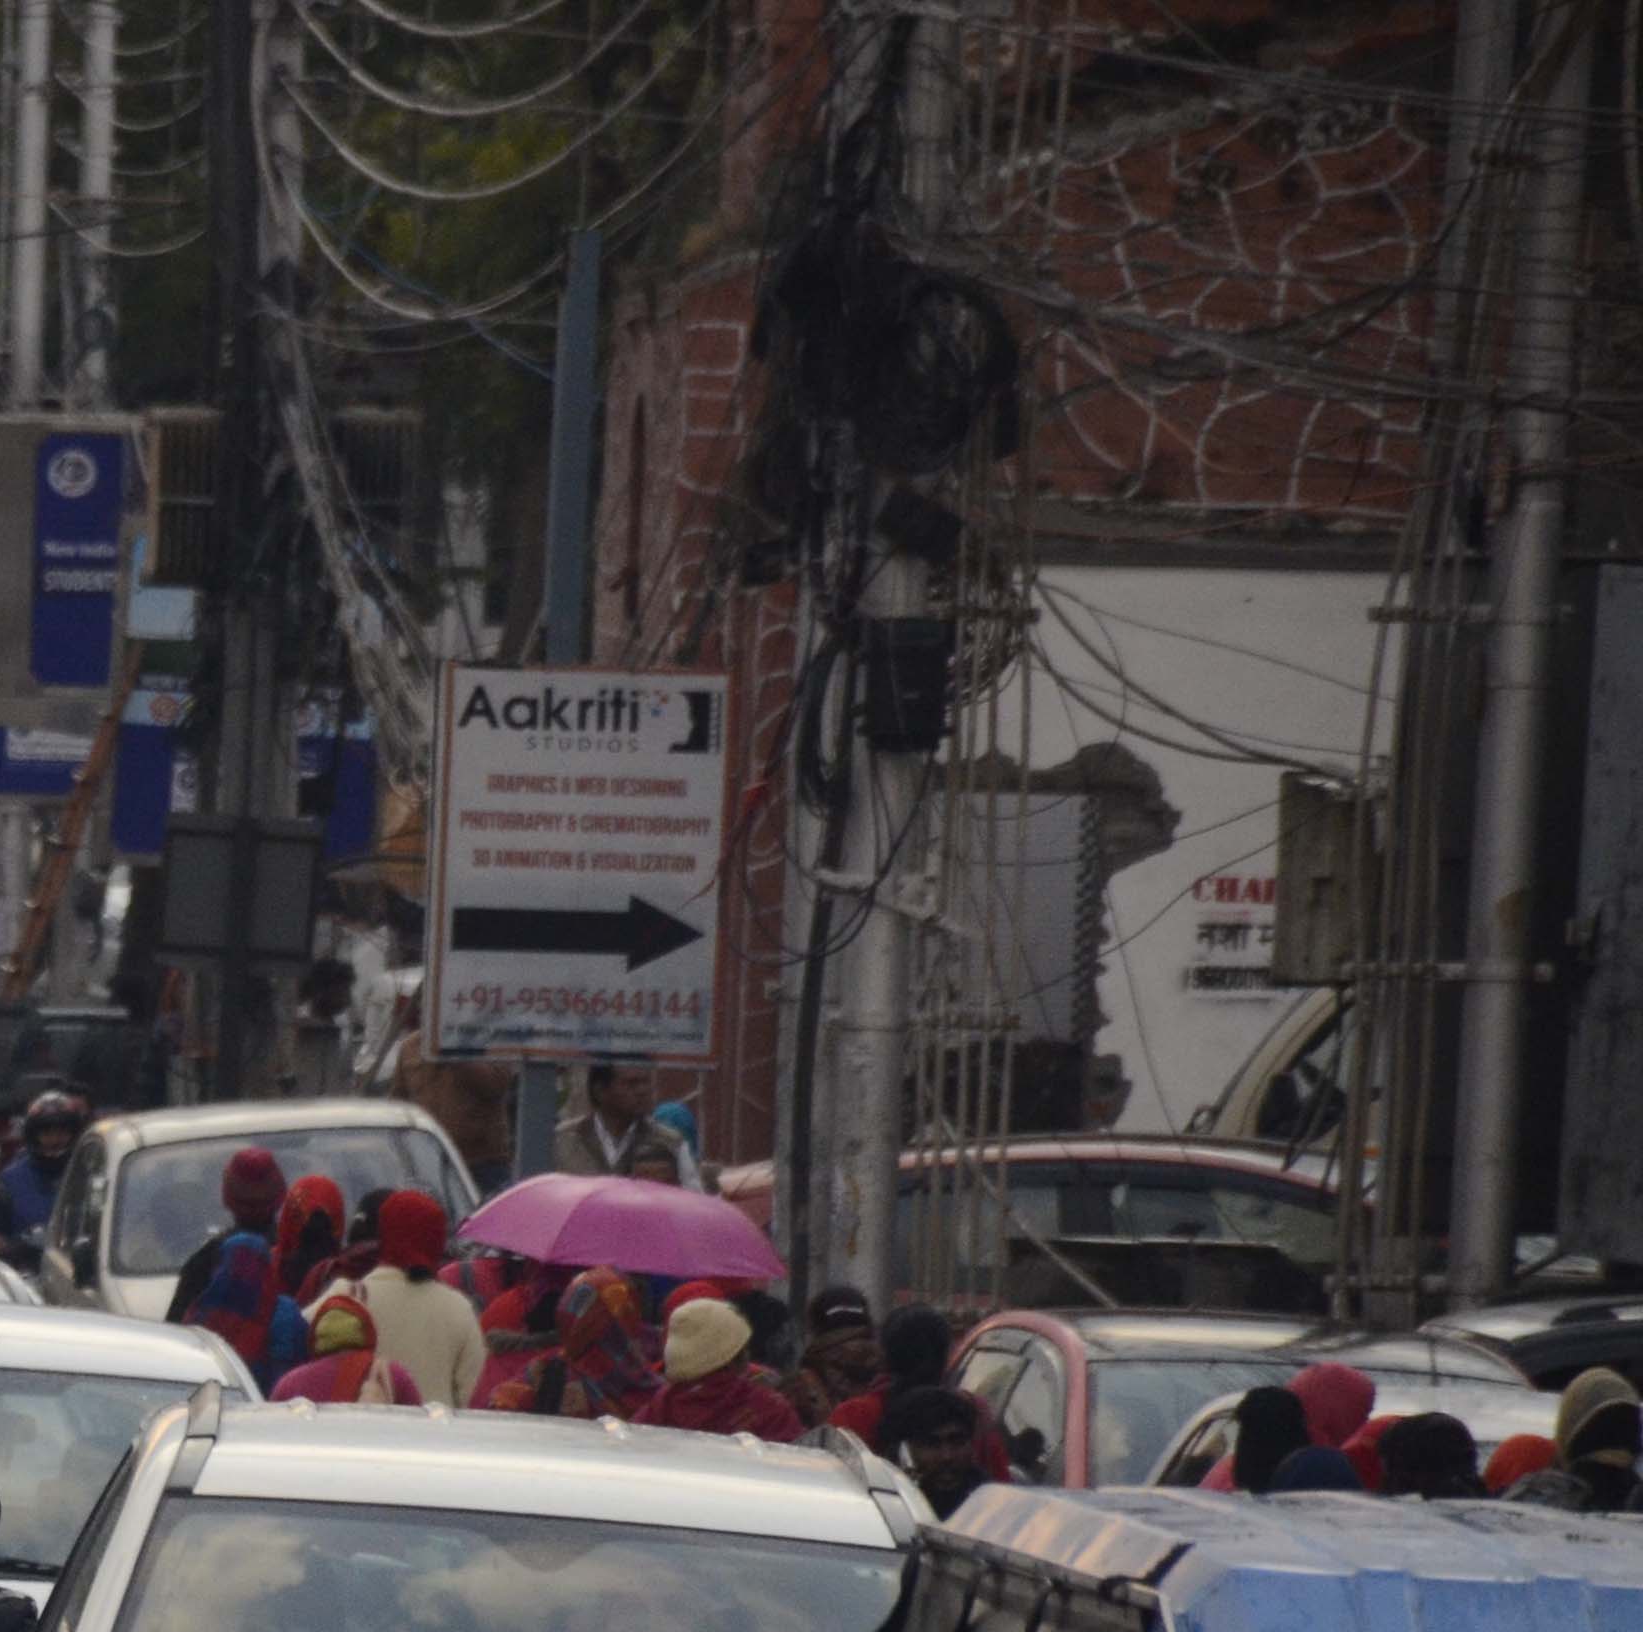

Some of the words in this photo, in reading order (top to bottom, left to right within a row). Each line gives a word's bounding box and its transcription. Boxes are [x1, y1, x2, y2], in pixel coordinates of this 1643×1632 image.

[458, 684, 640, 733] Aakriti
[527, 735, 639, 754] STUDIOS
[487, 773, 557, 794] GRAPHICS
[575, 776, 606, 795] WEB
[610, 777, 688, 798] DESIGNING
[460, 810, 562, 833] PHOTOGRAPHY
[580, 814, 711, 837] CINEMATOGRAPHY
[471, 849, 490, 868] 3D
[494, 850, 572, 870] ANIMATION
[591, 852, 697, 873] VISUALIZATION
[450, 985, 701, 1018] +91-9536644144
